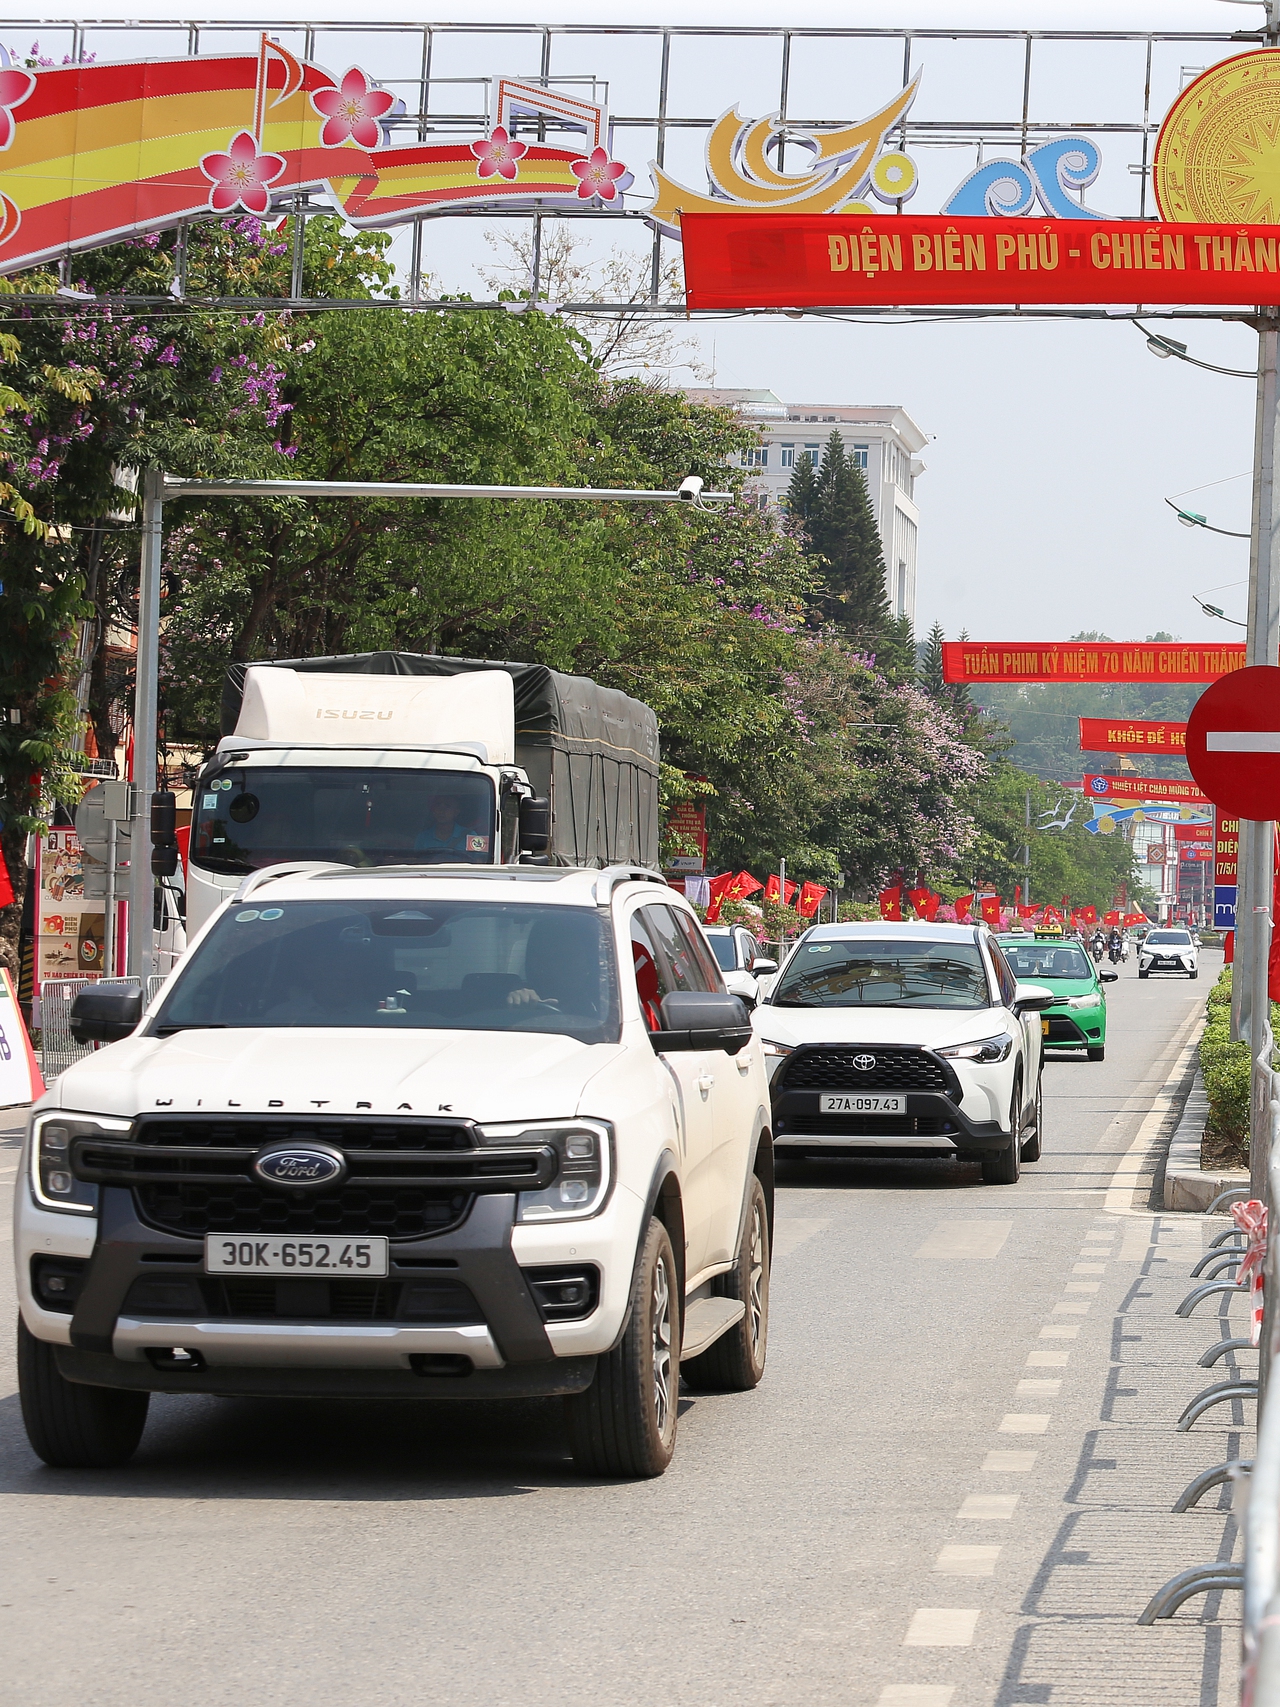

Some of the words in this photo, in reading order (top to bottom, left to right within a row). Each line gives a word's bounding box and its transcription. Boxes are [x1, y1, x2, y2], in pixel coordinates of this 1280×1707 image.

[827, 226, 903, 278] ĐIỆN
[911, 226, 987, 271] BIÊN
[995, 225, 1059, 271] PHỦ
[1069, 249, 1081, 257] -
[1090, 226, 1186, 270] CHIẾN
[963, 646, 999, 675] TUẦN
[1003, 652, 1038, 674] PHIM
[1041, 646, 1058, 674] KỶ
[1063, 648, 1099, 678] NIỆM
[1102, 652, 1119, 674] 70
[1122, 647, 1154, 674] NĂM
[1158, 647, 1199, 673] CHIẾN
[316, 708, 393, 720] ISUZU
[1107, 726, 1144, 744] KHỎE
[1147, 726, 1166, 744] ĐỂ
[1133, 782, 1147, 794] LIỆT
[1149, 782, 1168, 795] CHÀO
[1190, 787, 1199, 797] 70
[155, 1098, 454, 1113] WILDTRAK
[827, 1098, 899, 1110] 27A-097.43
[274, 1156, 320, 1179] Ford
[222, 1242, 371, 1268] 30K-652.45
